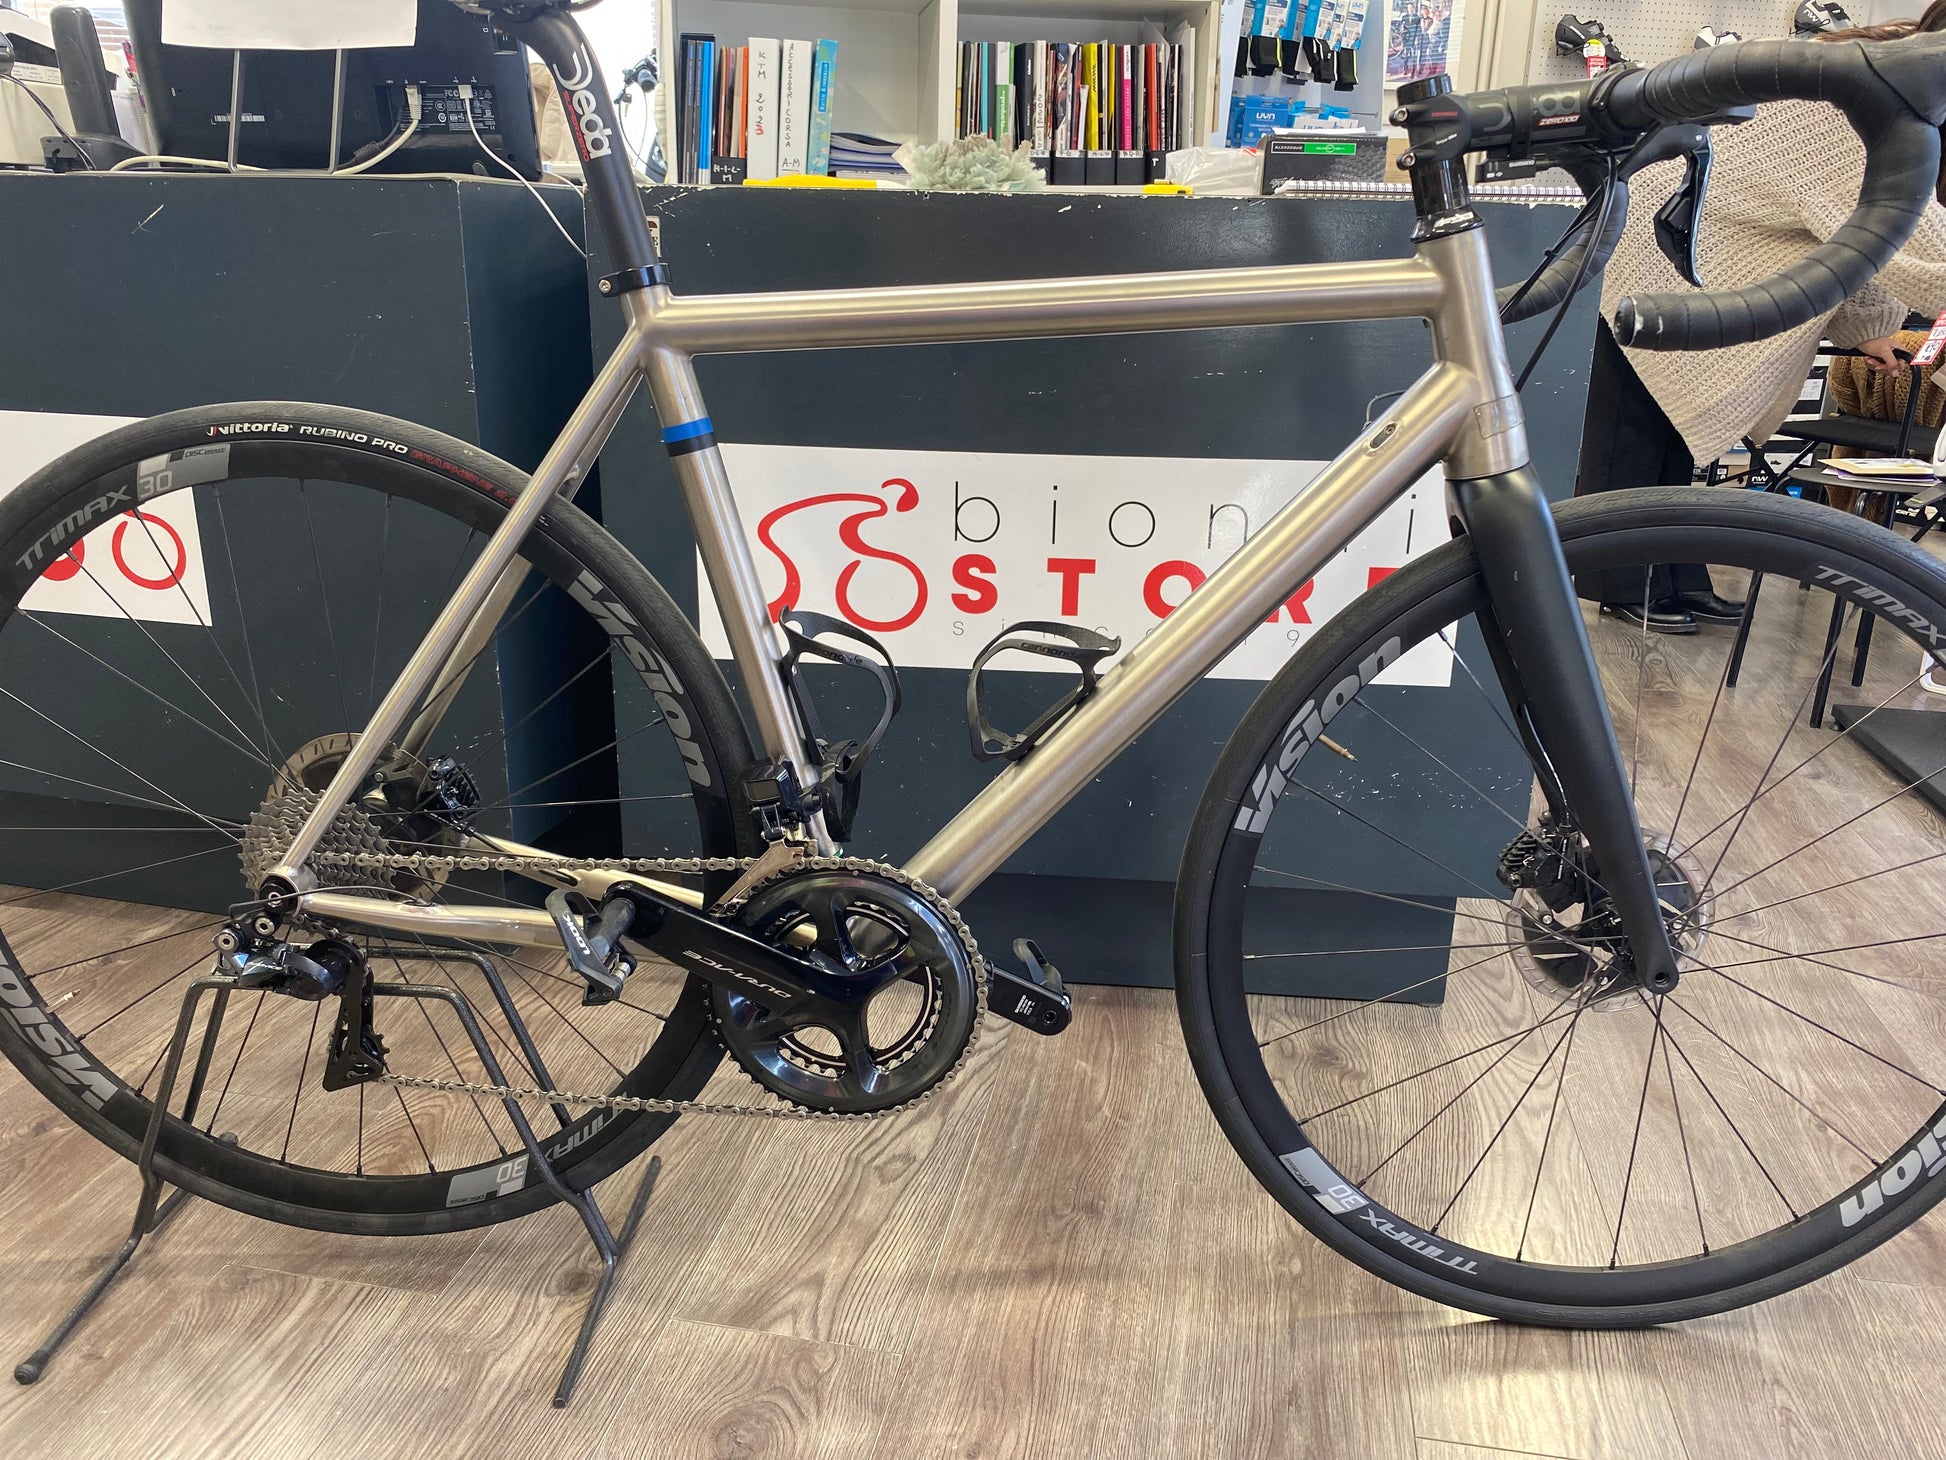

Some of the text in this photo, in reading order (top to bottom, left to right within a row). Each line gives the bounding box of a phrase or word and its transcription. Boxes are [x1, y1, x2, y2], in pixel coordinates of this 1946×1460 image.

[757, 50, 767, 80] KTM
[781, 158, 801, 168] A-M
[300, 425, 369, 444] RUBINO
[371, 437, 409, 455] PRO
[139, 470, 173, 498] 30
[562, 914, 591, 955] LOOK
[682, 949, 792, 999] DURA-ACE
[496, 1157, 528, 1184] 30
[1327, 1184, 1370, 1209] 30
